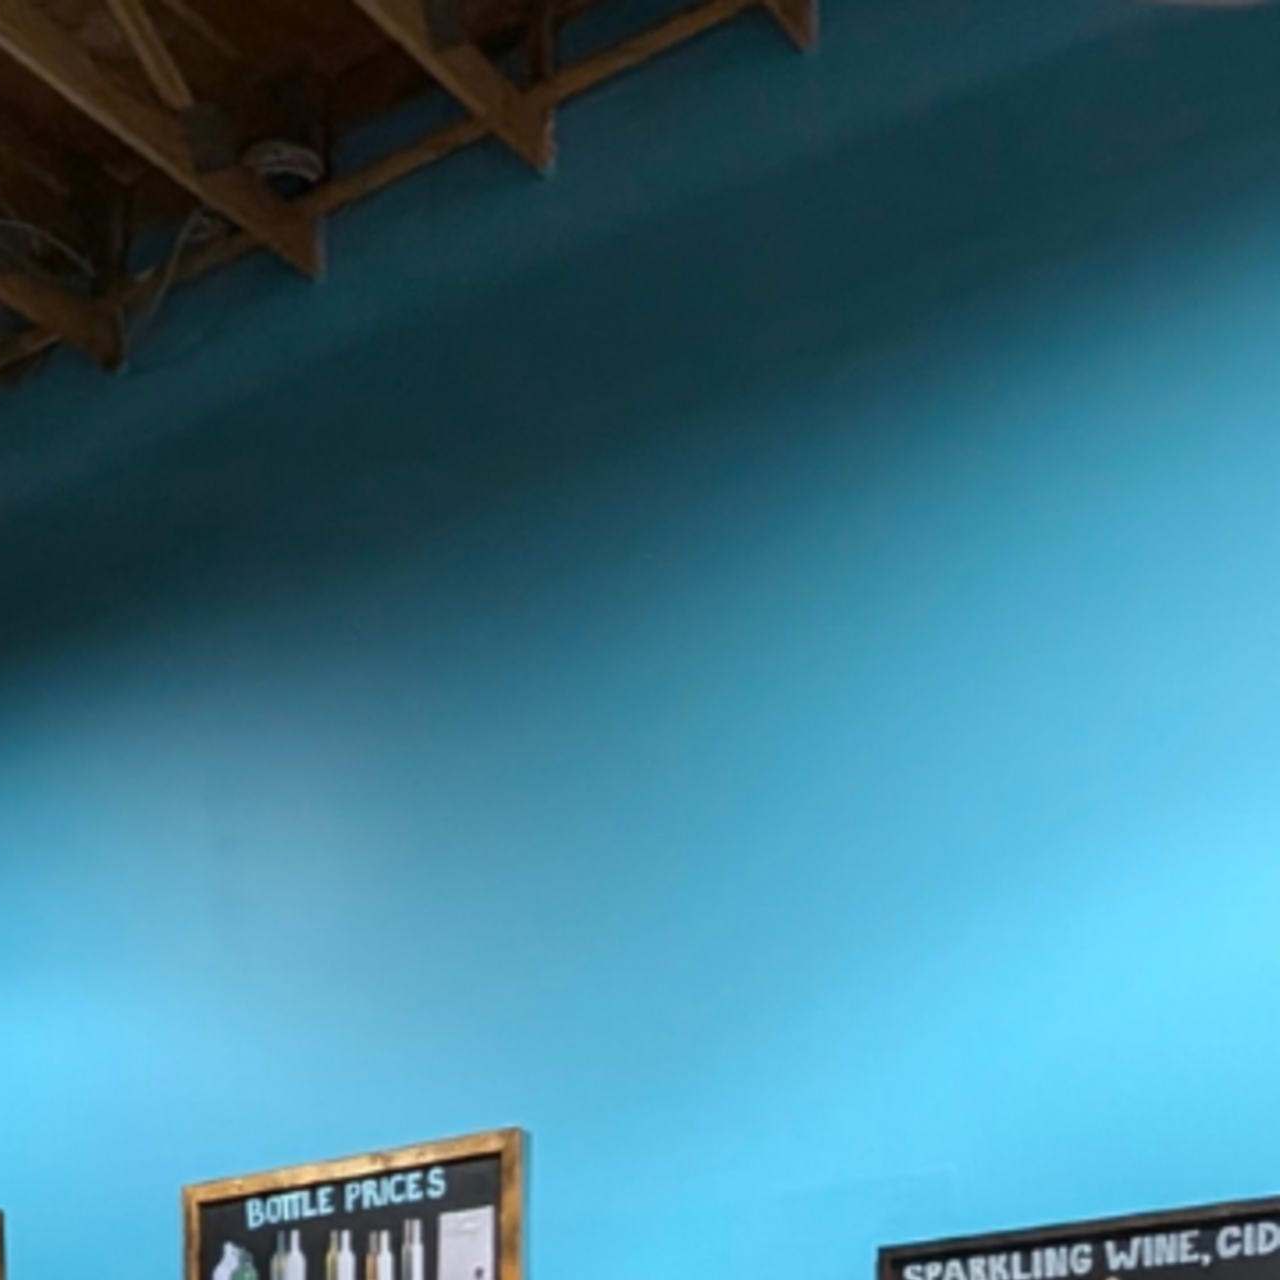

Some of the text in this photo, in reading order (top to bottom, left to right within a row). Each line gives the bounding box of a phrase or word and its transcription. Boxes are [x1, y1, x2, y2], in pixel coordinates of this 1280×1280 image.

[245, 1167, 447, 1230] BOTTLE PRICES
[1105, 1229, 1212, 1271] WINE,
